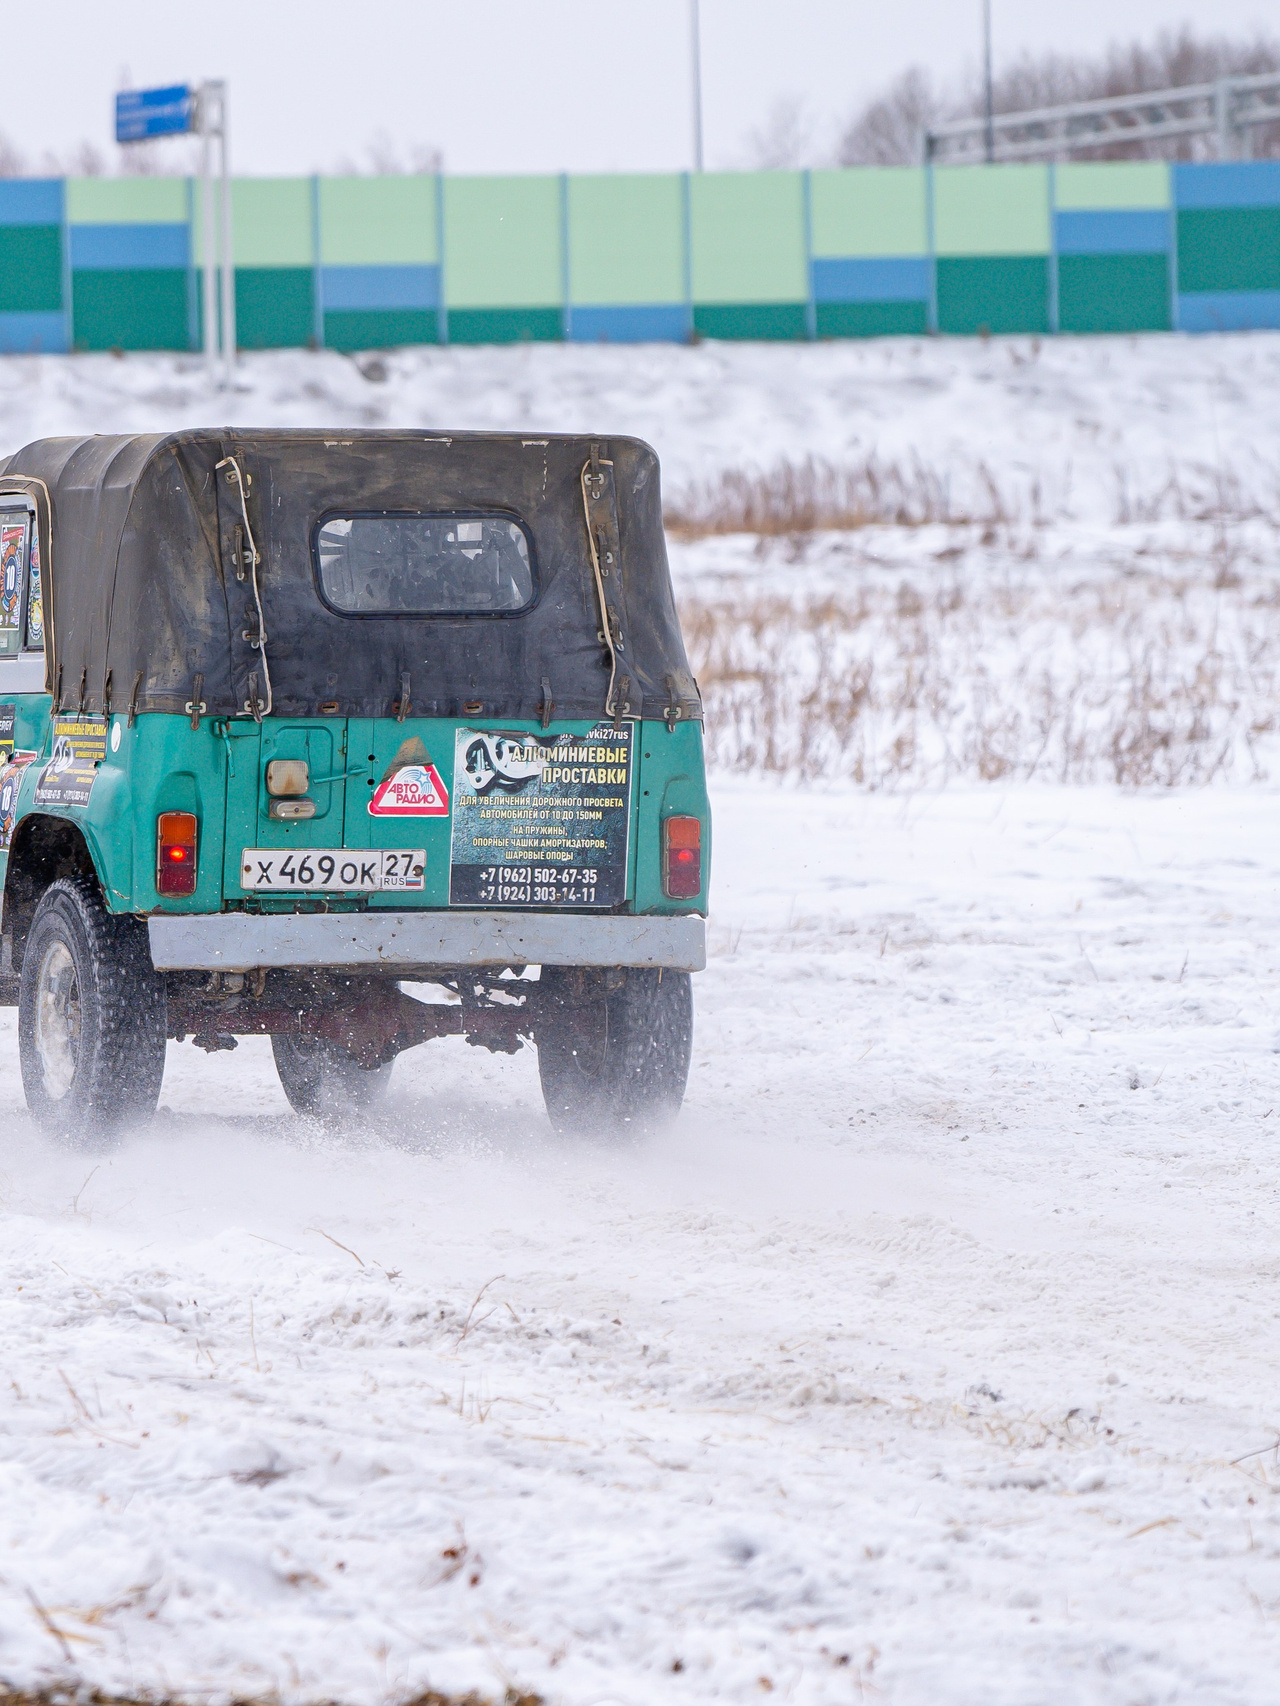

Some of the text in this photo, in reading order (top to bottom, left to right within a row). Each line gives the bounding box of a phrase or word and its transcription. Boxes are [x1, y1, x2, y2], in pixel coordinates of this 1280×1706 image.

[6, 565, 15, 591] 10
[511, 746, 627, 763] АЛЮМИНИЕВЫЕ
[542, 767, 626, 784] ПРОСТАВКИ
[387, 783, 419, 794] АВТО
[1, 785, 12, 812] 18
[396, 794, 436, 804] РАДИО
[460, 796, 624, 807] ДЛЯ УВЕЛИЧЕНИЯ ДОРОЖНОГО ПРОСВЕТА
[480, 809, 602, 820] АВТОМОБИЛЕЙ ОТ 10 ДО 150ММ
[513, 826, 568, 836] НА ПРУЖИНЫ,
[472, 838, 608, 849] ОПОРНЫЕ ЧАШКИ АМОРТИЗАТОРОВ,
[506, 851, 574, 860] ШАРОВЫЕ ОПОРЫ
[385, 854, 414, 877] 27
[480, 866, 598, 884] +7 (962) 502-67-35
[383, 877, 405, 886] RUS
[480, 885, 596, 902] +7 (924) 303-14-11
